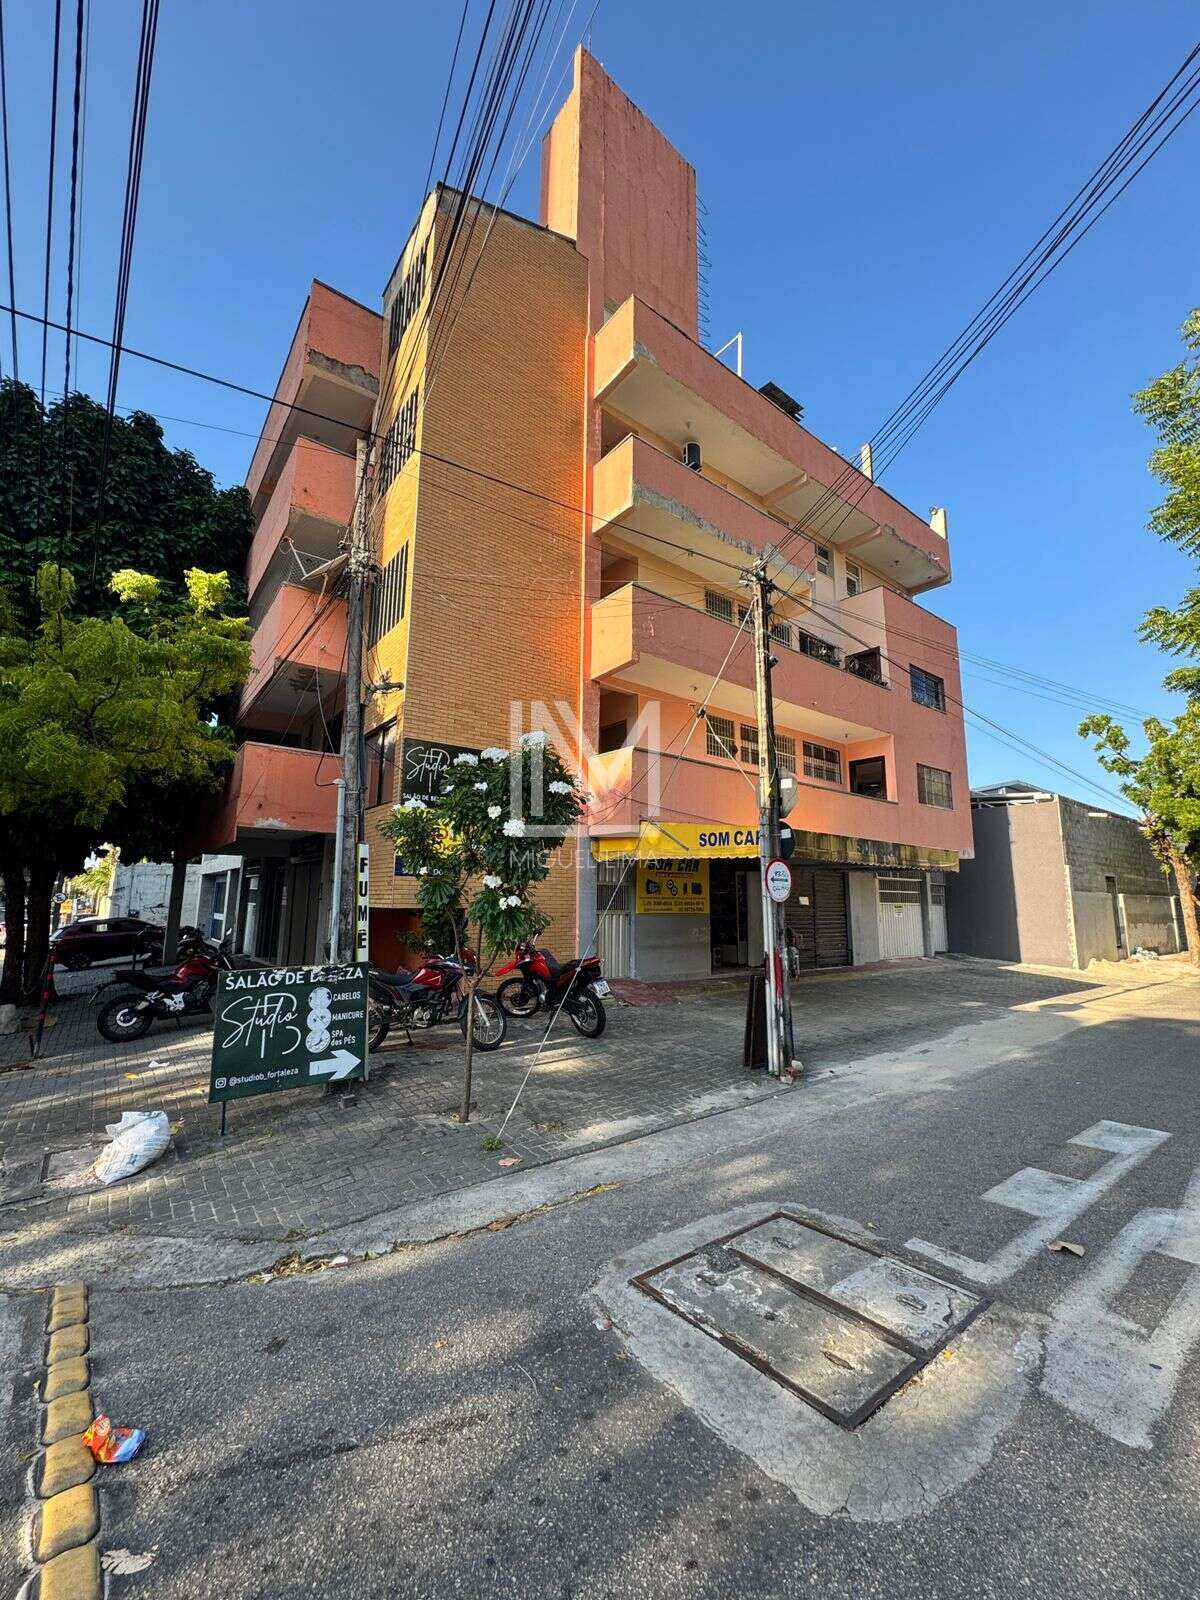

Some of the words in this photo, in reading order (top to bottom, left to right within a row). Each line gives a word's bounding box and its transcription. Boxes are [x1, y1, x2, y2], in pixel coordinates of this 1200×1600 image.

[699, 831, 730, 848] SOM
[286, 971, 305, 985] DE
[332, 991, 361, 1001] CABELOS
[221, 995, 298, 1049] Studio
[332, 1010, 365, 1021] MANICURE
[331, 1029, 344, 1038] SPA
[229, 1067, 299, 1086] @studiob_fortaleza
